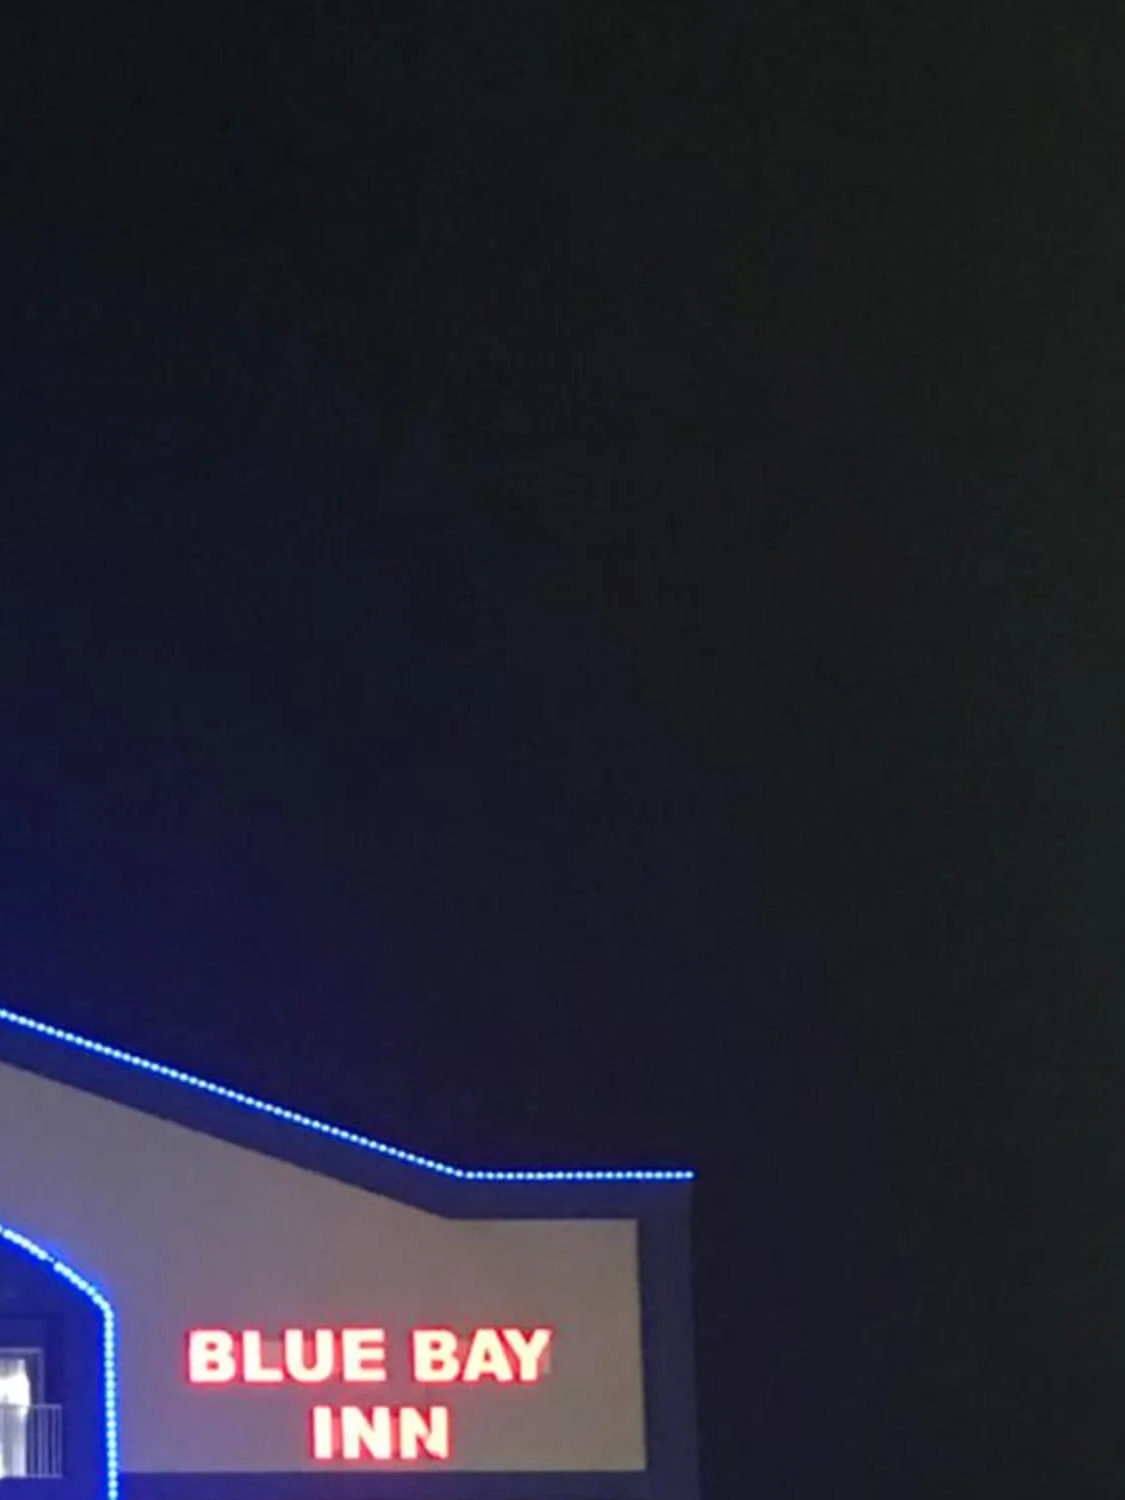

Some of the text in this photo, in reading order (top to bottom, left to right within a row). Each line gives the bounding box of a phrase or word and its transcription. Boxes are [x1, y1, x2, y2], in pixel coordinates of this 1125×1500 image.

[187, 1327, 553, 1383] BLUE BAY
[312, 1405, 450, 1460] INN
